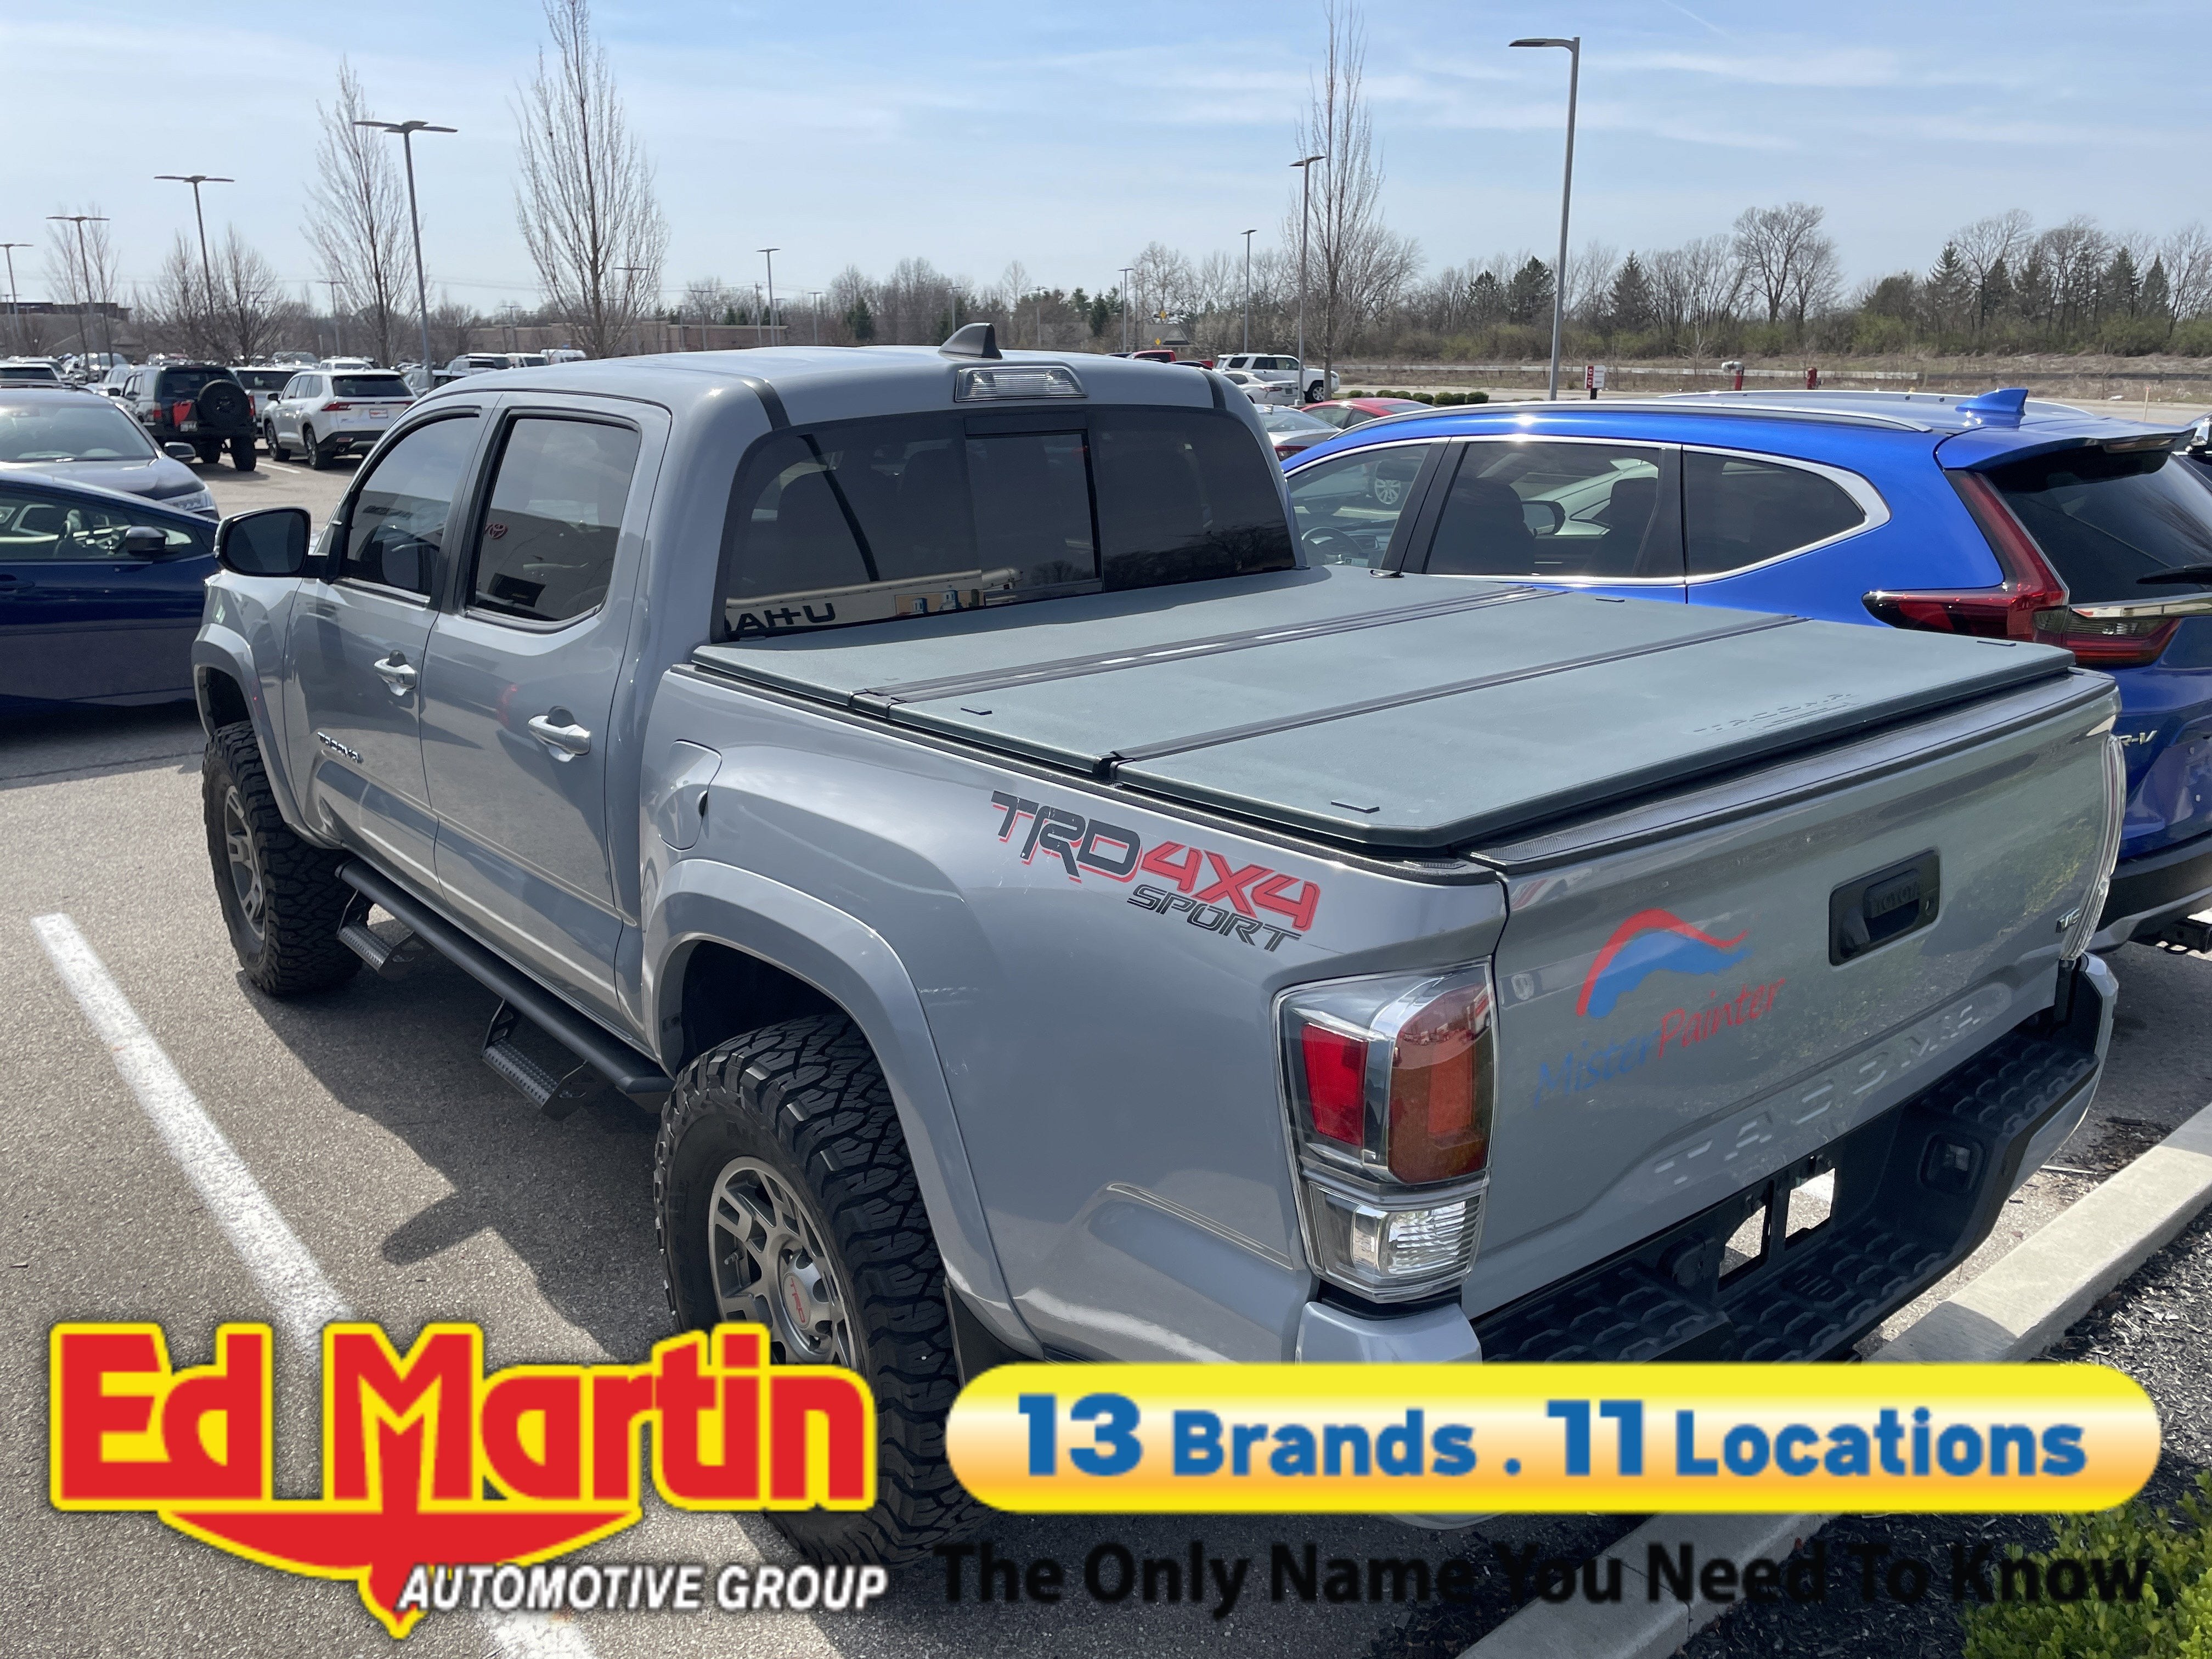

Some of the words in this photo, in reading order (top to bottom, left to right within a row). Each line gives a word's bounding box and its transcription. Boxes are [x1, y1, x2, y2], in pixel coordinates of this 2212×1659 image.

[2117, 730, 2157, 747] R-V
[991, 790, 1143, 884] TRD
[1126, 884, 1302, 952] SPORT
[790, 1278, 805, 1323] TRD
